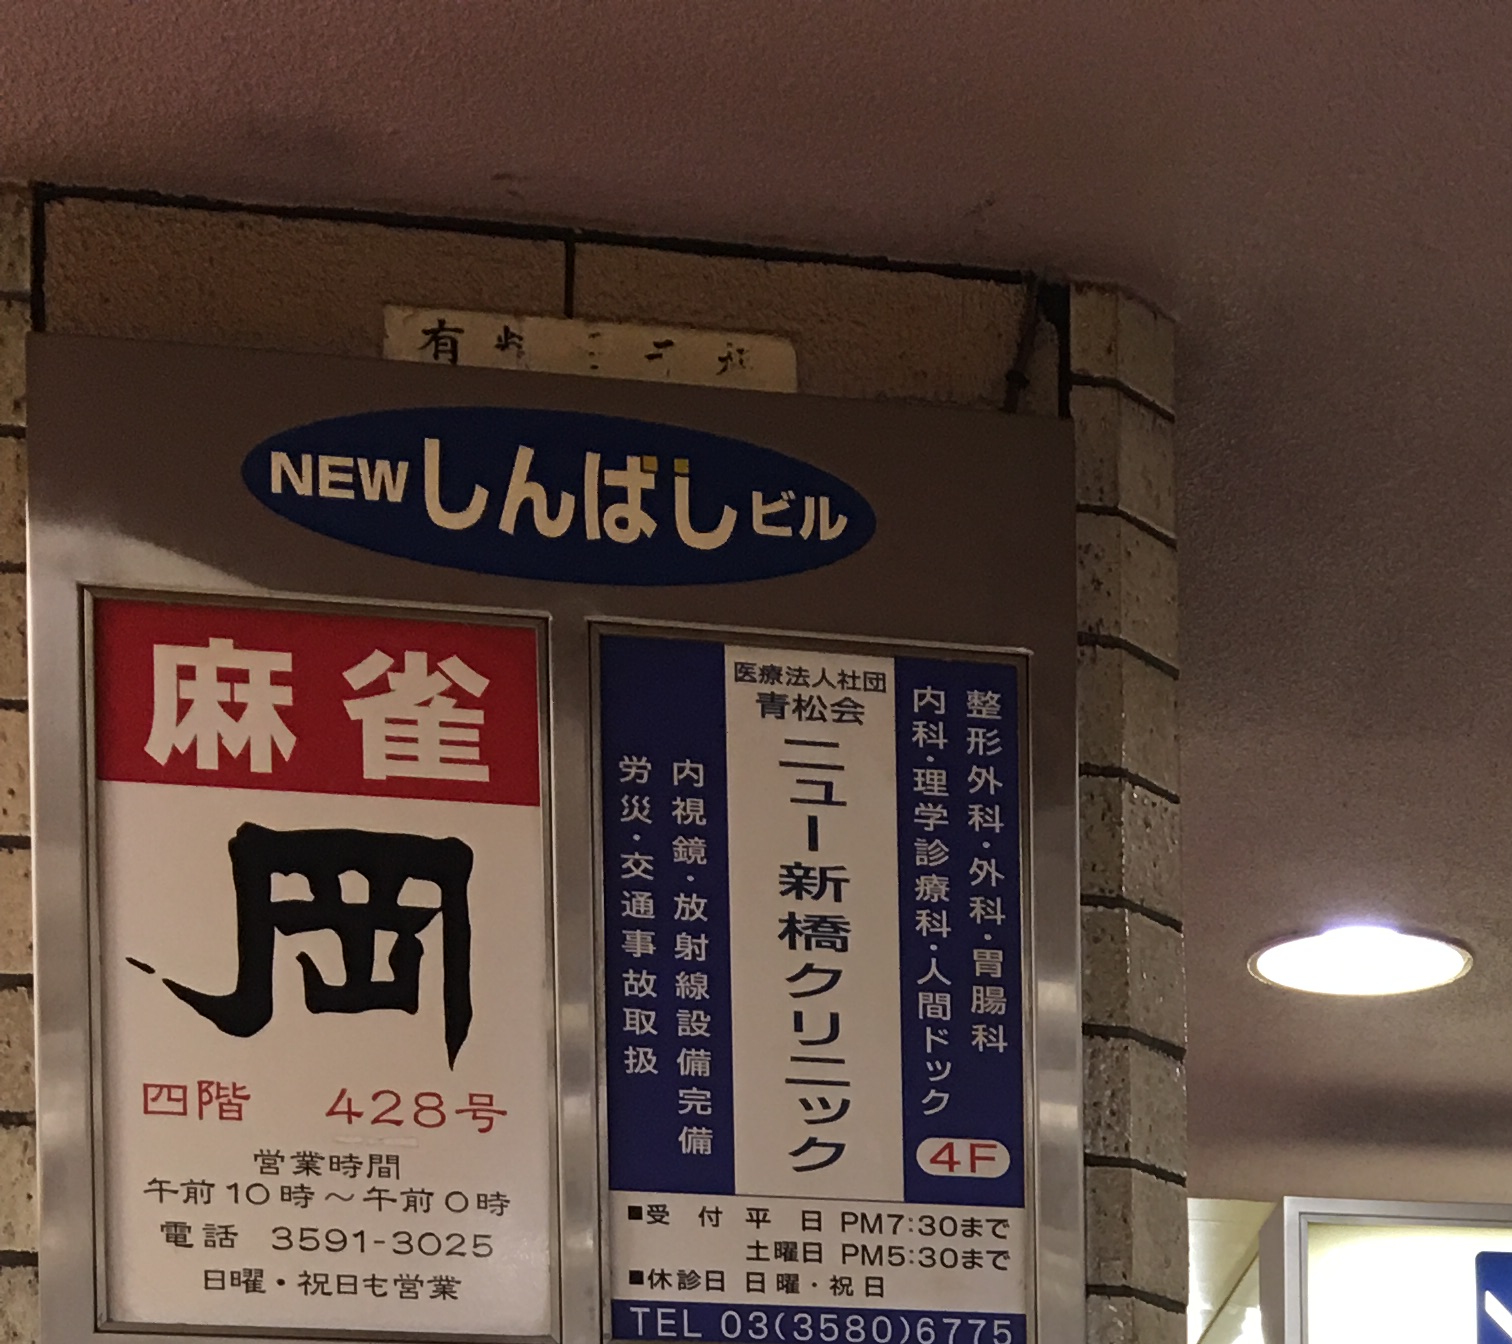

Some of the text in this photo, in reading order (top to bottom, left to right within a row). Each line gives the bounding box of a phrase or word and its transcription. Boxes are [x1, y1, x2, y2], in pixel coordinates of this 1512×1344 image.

[734, 662, 887, 693] 医療法人社団
[143, 638, 490, 783] 麻雀
[755, 691, 866, 726] 青松会
[966, 689, 1008, 1053] 整形外科・外科・胃腸科
[618, 755, 658, 1076] 労災・交通事故取扱
[912, 686, 952, 1115] 内科・理学診療科・人間ドック
[126, 821, 475, 1070] 岡
[672, 758, 713, 1155] 内視鏡・放射線設備完備
[777, 738, 853, 1173] ニュー新橋クリニック
[142, 1079, 508, 1134] 四階 428号
[253, 1149, 402, 1181] 営業時間
[929, 1140, 1000, 1174] 4F
[160, 1221, 495, 1259] 電話 3591-3025
[841, 1211, 1010, 1241] PM7:30まで
[745, 1240, 1011, 1272] 土曜日 PM5:30まで
[202, 1268, 462, 1302] 日曜・祝日も営業
[647, 1269, 726, 1293] 休診日
[629, 1306, 703, 1339] TEL
